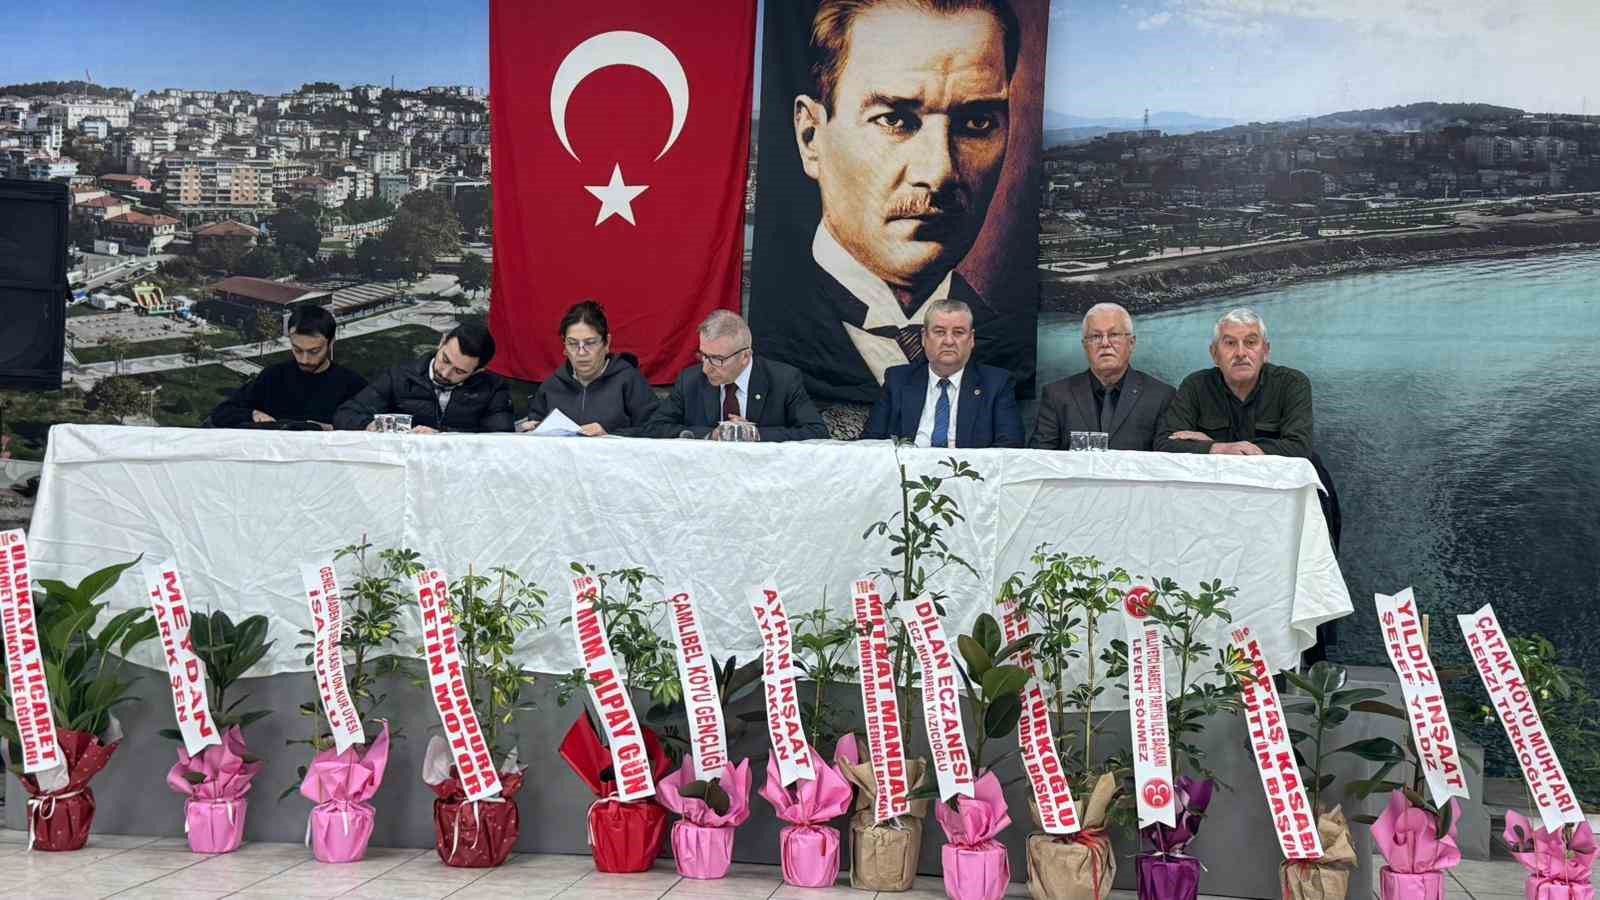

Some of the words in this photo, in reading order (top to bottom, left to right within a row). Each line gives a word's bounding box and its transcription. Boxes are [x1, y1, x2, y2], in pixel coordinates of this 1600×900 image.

[671, 593, 704, 664] ÇAMLIBEL
[763, 589, 792, 670] AYHAN
[915, 601, 952, 672] DİLAN
[916, 643, 936, 703] MUHARREM
[1132, 638, 1144, 694] LEVENT
[12, 675, 26, 694] VE
[26, 657, 57, 762] TİCARET
[170, 675, 188, 722] ŞEN
[315, 640, 341, 729] MUTLU
[448, 661, 496, 789] KUNDURA
[687, 664, 716, 704] KÖYÜ
[753, 605, 775, 676] AYHAN
[766, 683, 789, 761] AKMAN
[1381, 611, 1416, 685] ŞEREF
[1411, 694, 1438, 771] YILDIZ
[1467, 633, 1502, 693] REMZİ
[1497, 697, 1551, 808] TÜRKOĞLU
[1475, 616, 1515, 676] ÇATAK
[1506, 677, 1539, 728] KÖYÜ
[1528, 731, 1575, 813] MUHTARI
[435, 683, 481, 796] MOTOR
[589, 669, 636, 740] ALPAY
[617, 742, 649, 796] GÜN
[693, 705, 727, 773] GENÇLİĞİ
[1029, 682, 1076, 828] TÜRKOĞLU
[1136, 698, 1149, 763] SÖNMEZ
[1425, 694, 1463, 789] İNŞAAT
